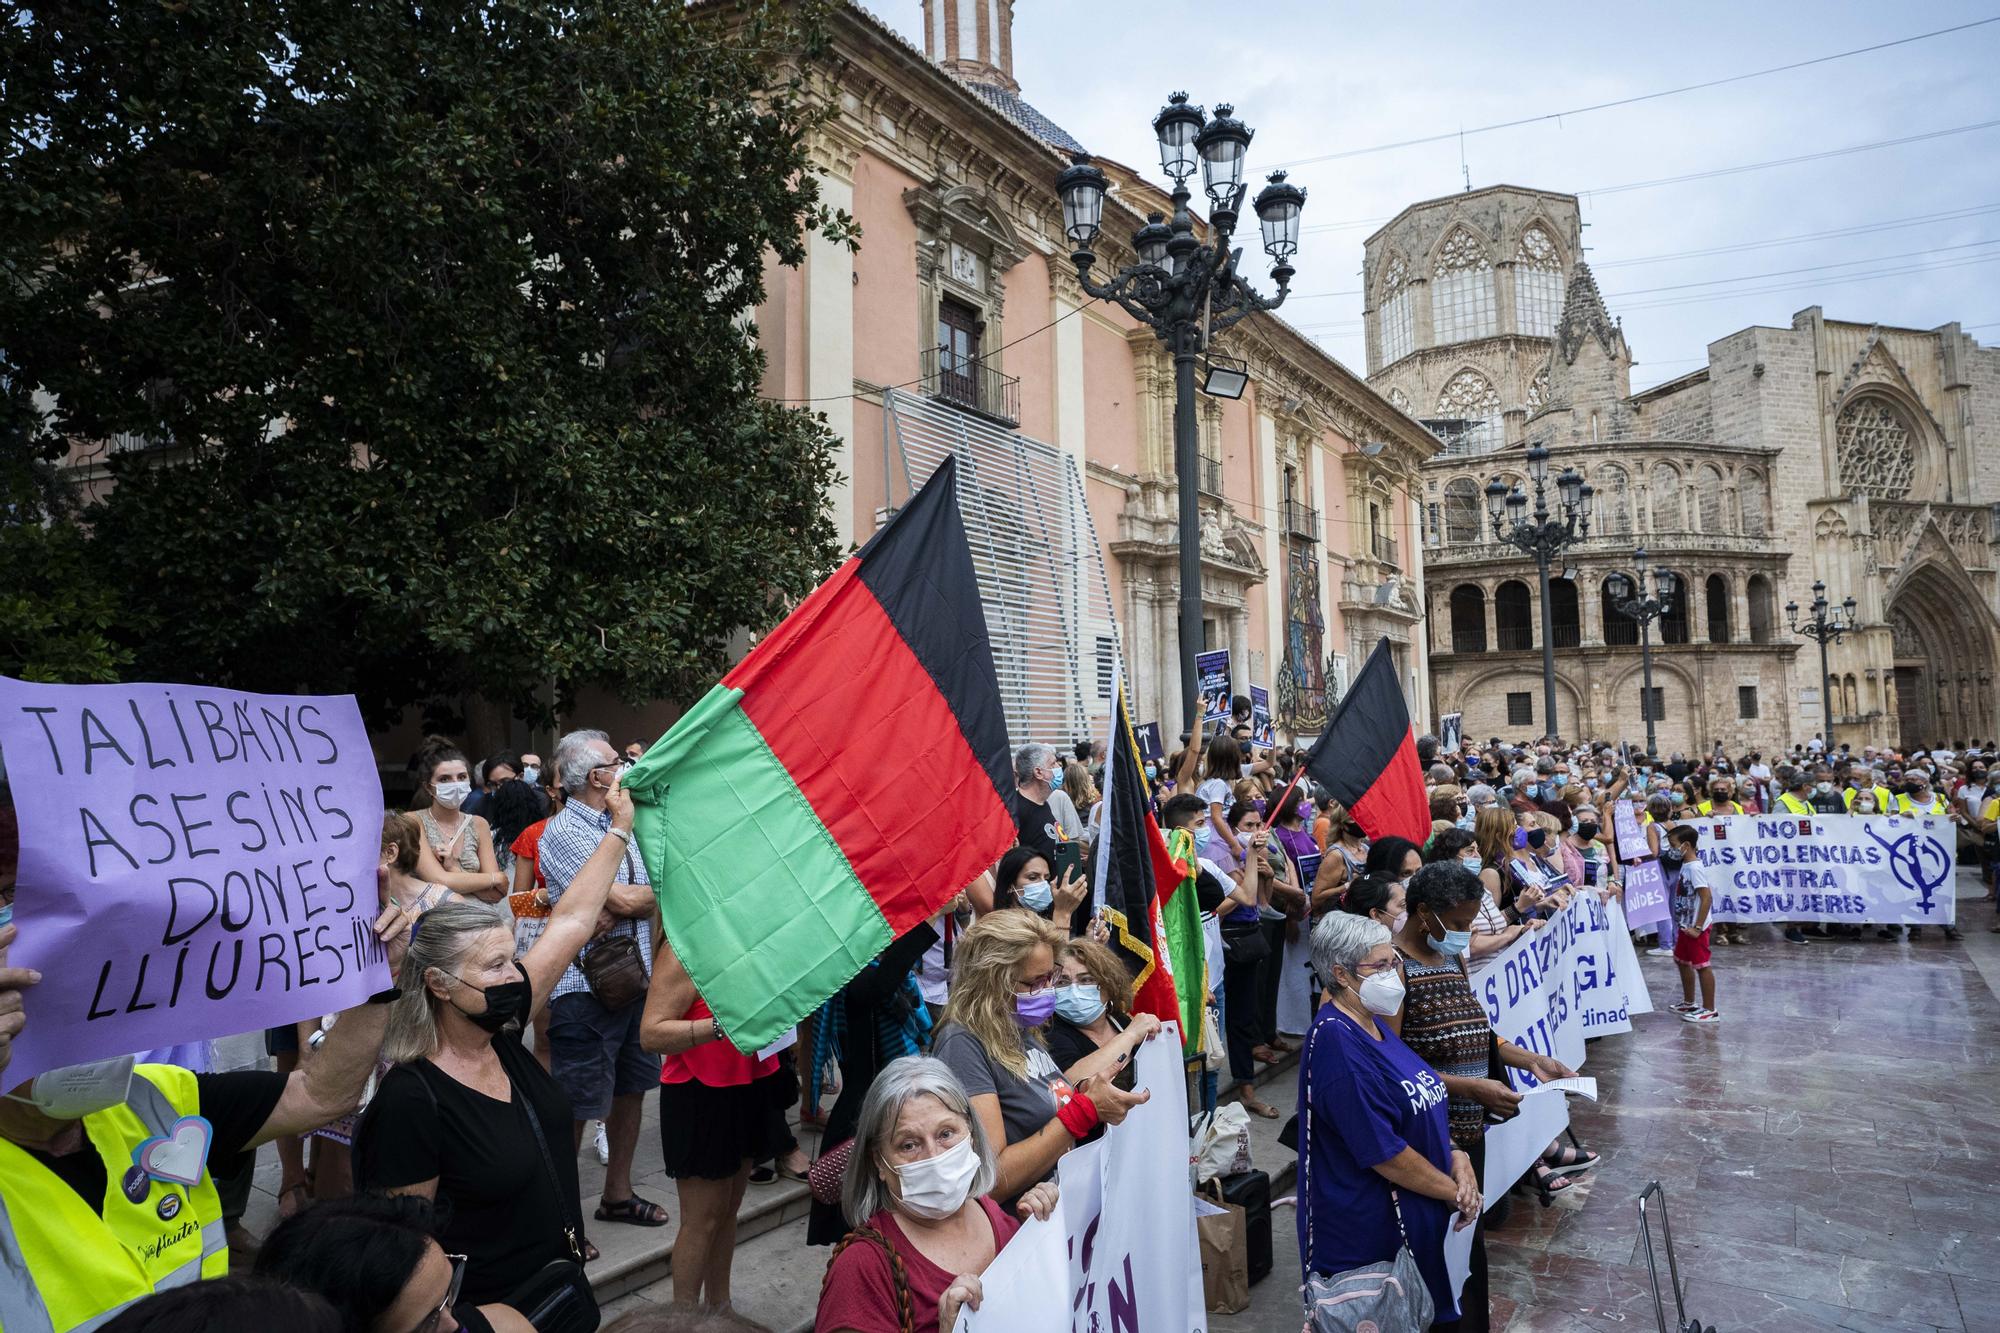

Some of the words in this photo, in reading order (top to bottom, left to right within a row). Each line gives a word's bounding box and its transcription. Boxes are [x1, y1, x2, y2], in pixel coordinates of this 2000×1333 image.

[1758, 821, 1797, 839] NO
[1740, 844, 1881, 865] VIOLENCIAS
[1734, 869, 1838, 889] CONTRA
[162, 856, 355, 946] DONES
[1755, 893, 1866, 914] MUJERES
